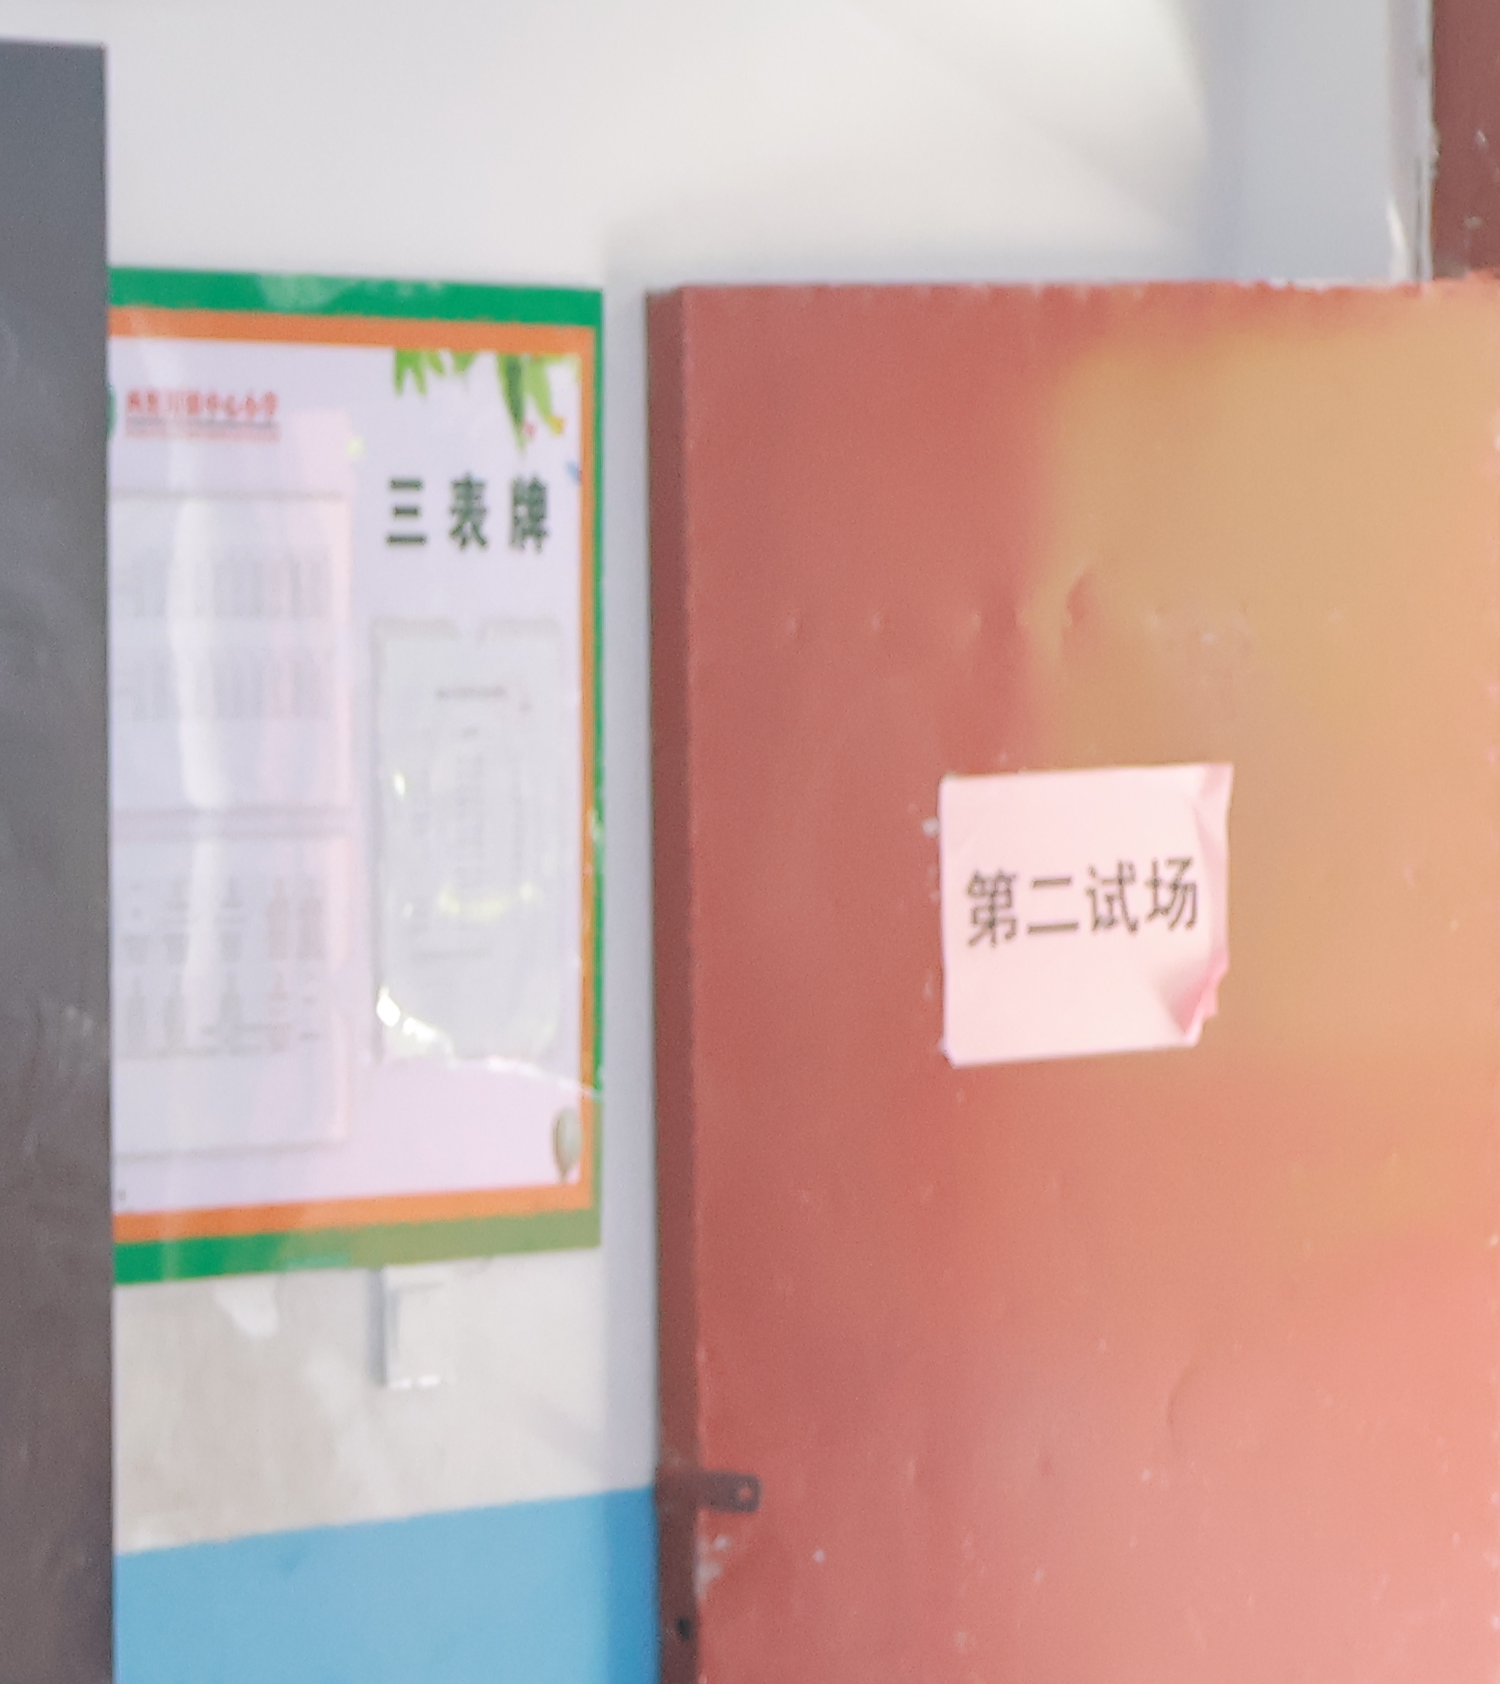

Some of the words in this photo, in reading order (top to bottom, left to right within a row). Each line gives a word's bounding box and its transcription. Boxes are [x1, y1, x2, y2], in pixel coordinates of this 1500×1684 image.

[386, 472, 549, 553] 三表牌
[966, 856, 1198, 948] 第二试场
